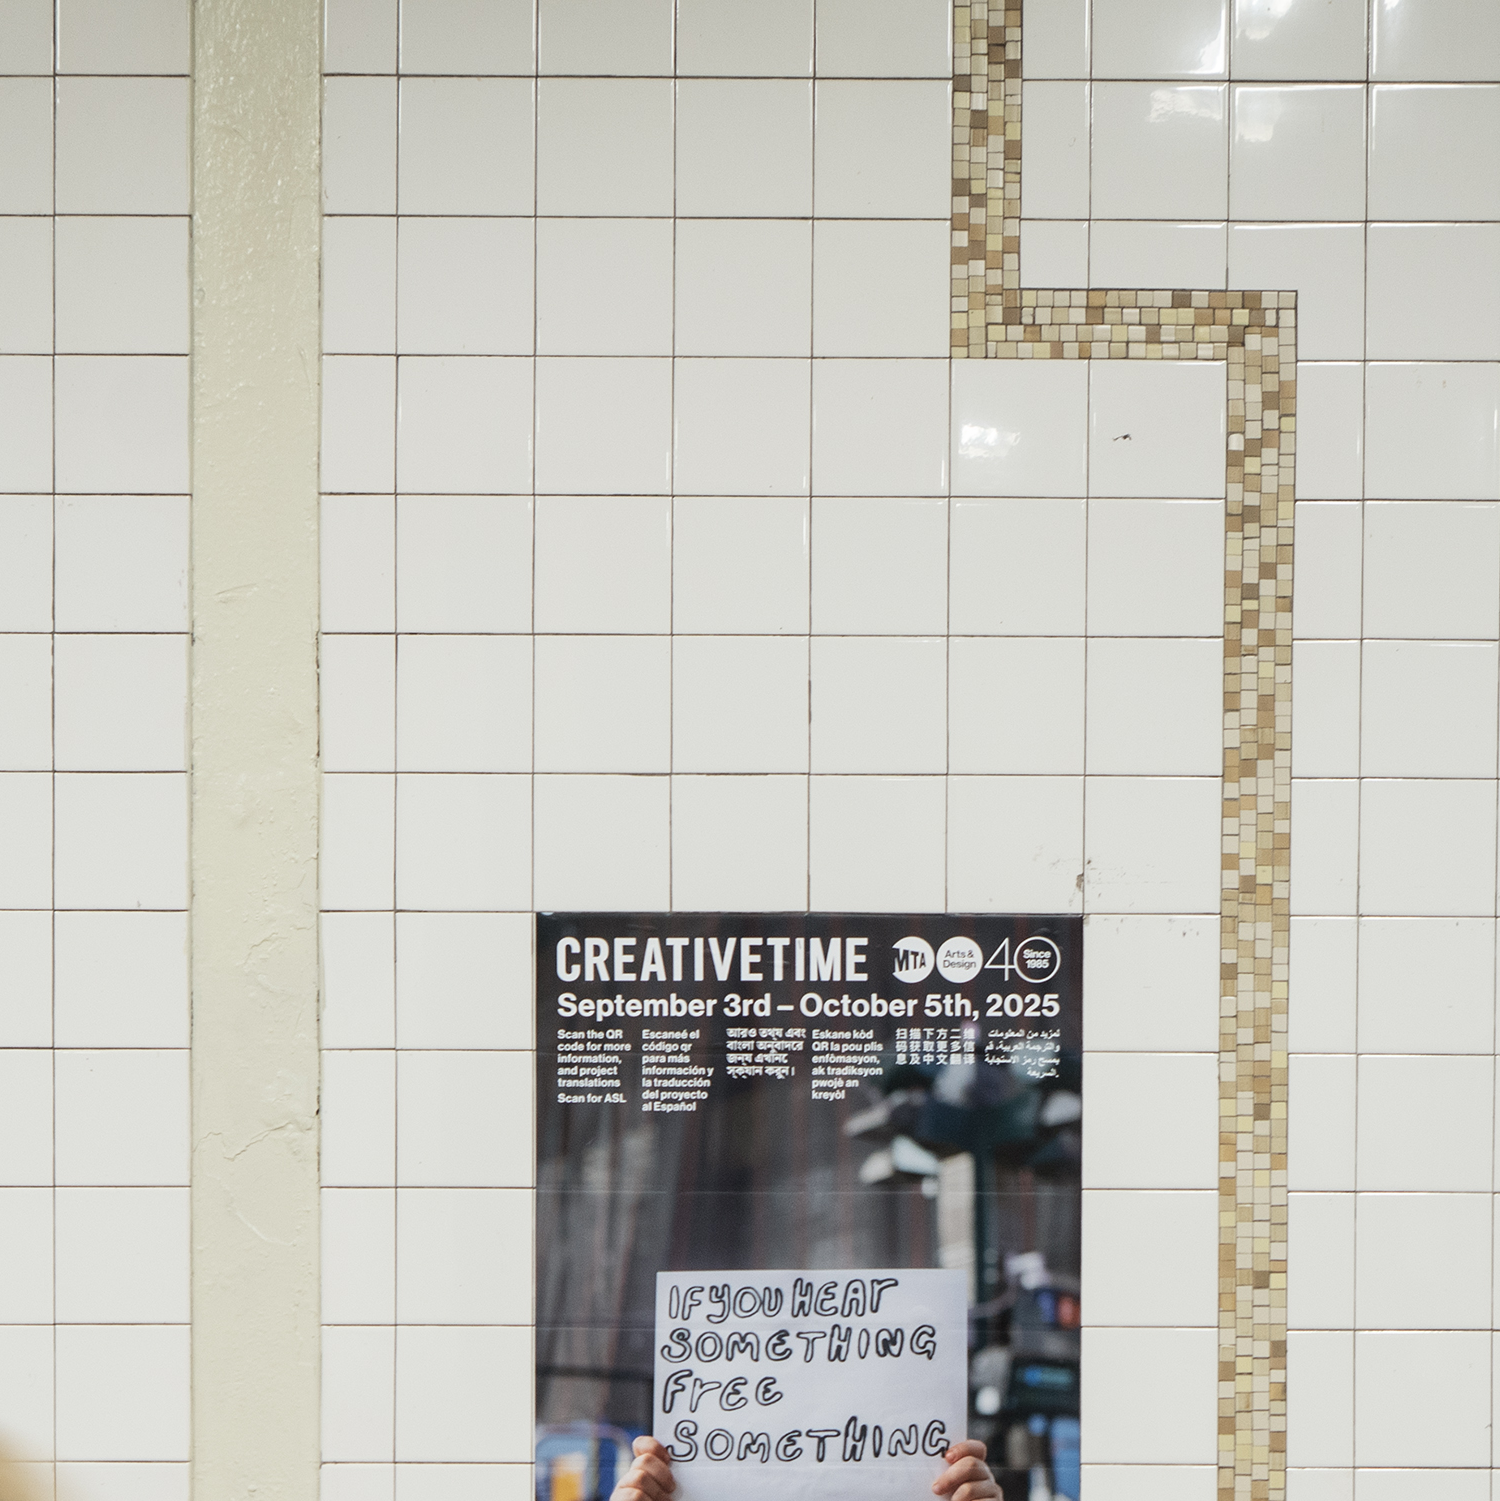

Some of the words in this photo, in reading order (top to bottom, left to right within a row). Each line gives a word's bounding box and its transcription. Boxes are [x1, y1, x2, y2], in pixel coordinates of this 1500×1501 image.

[944, 949, 966, 959] Arts
[967, 949, 975, 959] &
[1022, 949, 1052, 959] Since
[893, 945, 929, 975] MTA
[942, 959, 977, 970] Design
[1024, 959, 1050, 969] 1985
[557, 992, 718, 1022] September
[722, 992, 772, 1018] 3rd
[799, 992, 918, 1018] October
[923, 992, 980, 1022] 5th,
[985, 992, 1061, 1018] 2025
[557, 1029, 585, 1039] Scan
[586, 1029, 605, 1039] the
[605, 1029, 623, 1039] QR
[642, 1029, 688, 1039] Escaneé
[689, 1029, 700, 1039] el
[811, 1029, 851, 1040] Eskane
[852, 1029, 874, 1040] kòd
[895, 1028, 976, 1040] 扫描下方二维
[557, 1041, 585, 1051] code
[586, 1041, 602, 1051] for
[603, 1042, 632, 1051] more
[642, 1041, 679, 1053] código
[680, 1042, 693, 1053] qr
[811, 1041, 829, 1051] QR
[830, 1041, 840, 1051] la
[841, 1042, 863, 1053] pou
[863, 1041, 883, 1053] plis
[895, 1040, 976, 1053] 码获取更多信
[557, 1053, 622, 1064] information,
[642, 1055, 667, 1065] para
[667, 1053, 690, 1063] más
[811, 1053, 881, 1065] enfòmasyon,
[895, 1053, 976, 1065] 息及中文翻译
[557, 1066, 578, 1075] and
[579, 1066, 618, 1077] project
[642, 1066, 706, 1075] información
[706, 1067, 714, 1077] y
[811, 1066, 826, 1076] ak
[827, 1066, 884, 1077] tradiksyon
[557, 1078, 621, 1087] translations
[642, 1078, 652, 1087] la
[653, 1078, 711, 1087] traducción
[811, 1078, 844, 1089] pwojè
[845, 1079, 859, 1088] an
[557, 1093, 585, 1103] Scan
[586, 1093, 603, 1103] for
[604, 1093, 627, 1103] ASL
[642, 1090, 659, 1100] del
[660, 1090, 708, 1101] proyecto
[811, 1089, 846, 1101] kreyòl
[642, 1101, 652, 1111] al
[653, 1101, 697, 1113] Español
[660, 1324, 937, 1363] SOMETHING
[666, 1416, 950, 1463] SOMETHING
